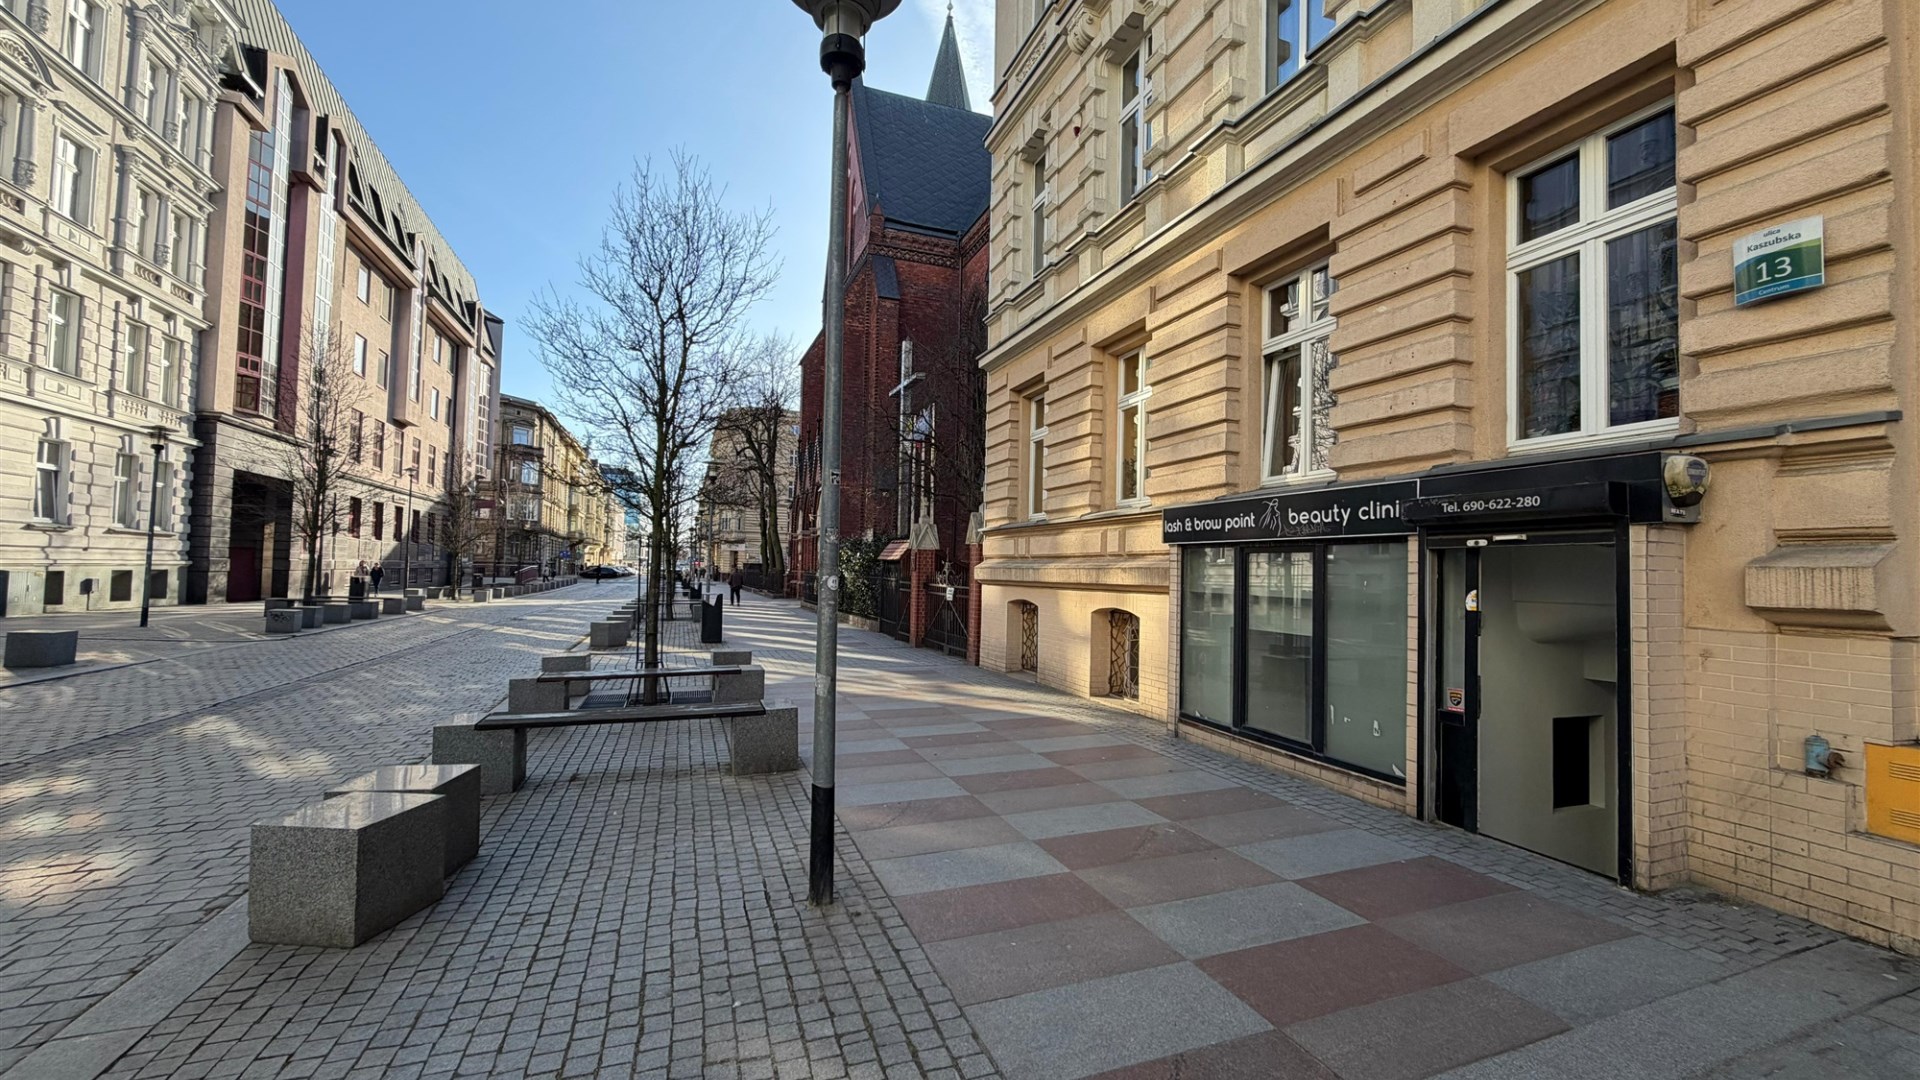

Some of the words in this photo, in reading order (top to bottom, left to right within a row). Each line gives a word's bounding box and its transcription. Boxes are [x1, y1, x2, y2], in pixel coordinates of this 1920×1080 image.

[1747, 232, 1801, 253] Kaszubska
[1763, 228, 1781, 238] ulica
[1756, 256, 1792, 283] 13
[1758, 284, 1790, 295] Centrum
[1441, 502, 1461, 513] Tel.
[1462, 495, 1541, 512] 690-622-280
[1164, 519, 1183, 533] lash
[1185, 517, 1192, 531] &
[1194, 517, 1222, 531] brow
[1225, 512, 1256, 532] point
[1288, 504, 1351, 527] beauty
[1358, 500, 1400, 520] clini
